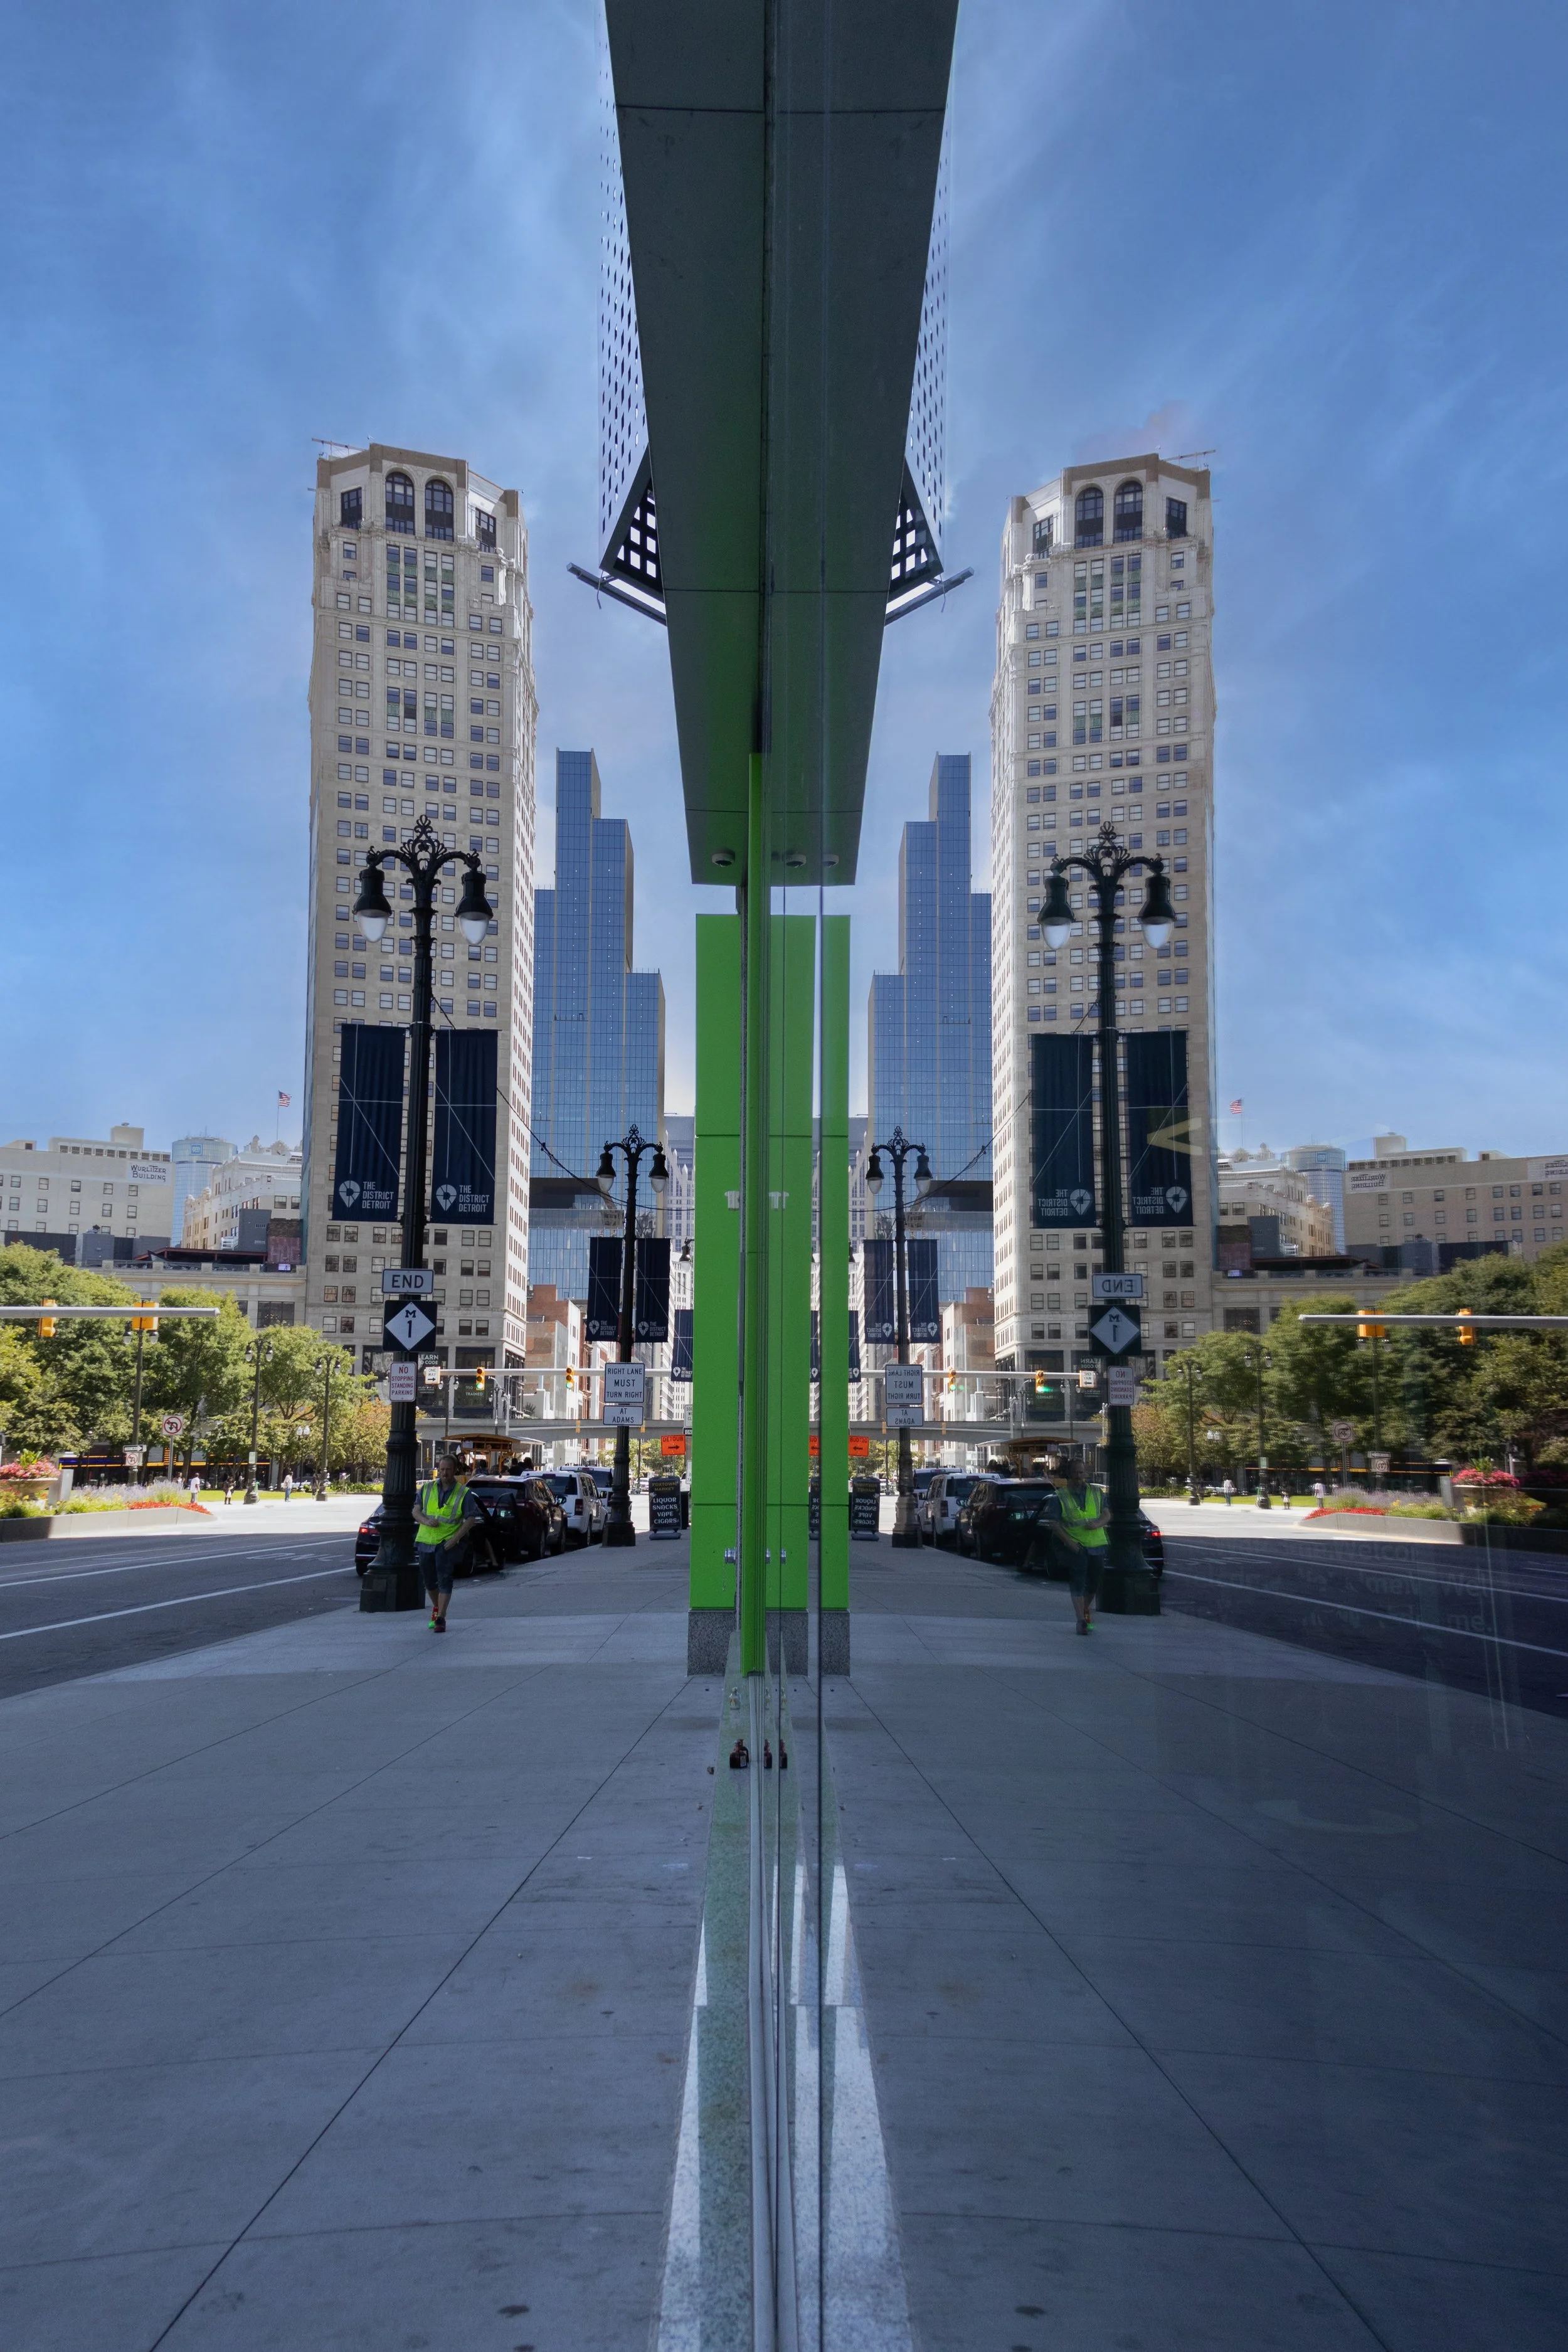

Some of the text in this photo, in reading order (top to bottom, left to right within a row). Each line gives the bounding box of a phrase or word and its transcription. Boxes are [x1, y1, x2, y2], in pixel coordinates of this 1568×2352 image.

[130, 1164, 167, 1173] WURLITZER
[132, 1170, 166, 1182] BUILDING
[363, 1182, 376, 1190] THE
[459, 1185, 472, 1194] THE
[363, 1191, 394, 1200] DISTRICT
[459, 1195, 490, 1203] DISTRICT
[362, 1200, 391, 1209] DETROIT
[458, 1204, 487, 1212] DETROIT
[392, 1274, 424, 1288] END
[405, 1310, 416, 1318] M
[407, 1320, 412, 1338] 1
